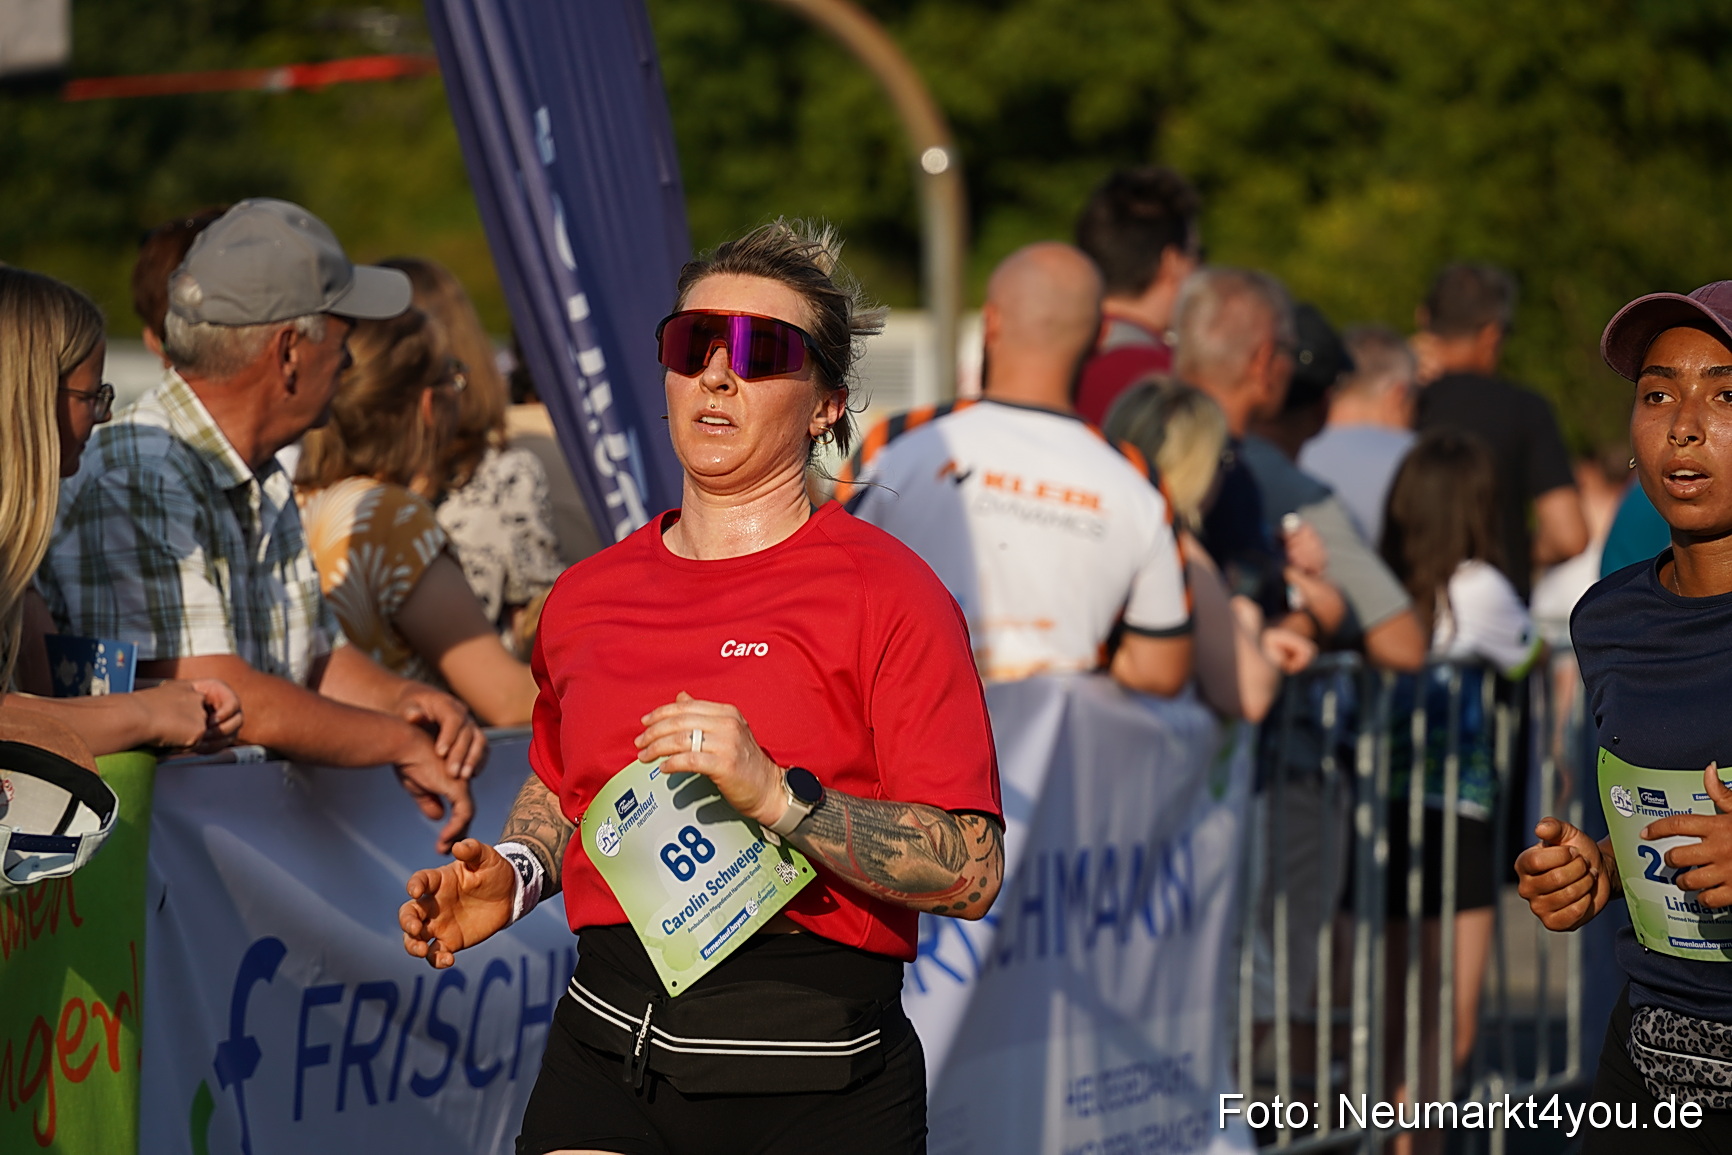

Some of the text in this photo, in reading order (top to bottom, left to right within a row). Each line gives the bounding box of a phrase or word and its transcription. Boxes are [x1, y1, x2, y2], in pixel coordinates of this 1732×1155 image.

[720, 639, 769, 658] Caro
[618, 791, 655, 836] Firmenlauf
[636, 802, 659, 828] neumarkt
[660, 825, 716, 882] 68
[661, 837, 767, 935] Carolin Schweiger
[687, 911, 711, 933] Ambulanter
[709, 891, 732, 914] Pflegedienst
[749, 863, 762, 878] GmbH
[703, 913, 747, 957] firmenlauf.bayern
[293, 946, 575, 1122] FRISCH
